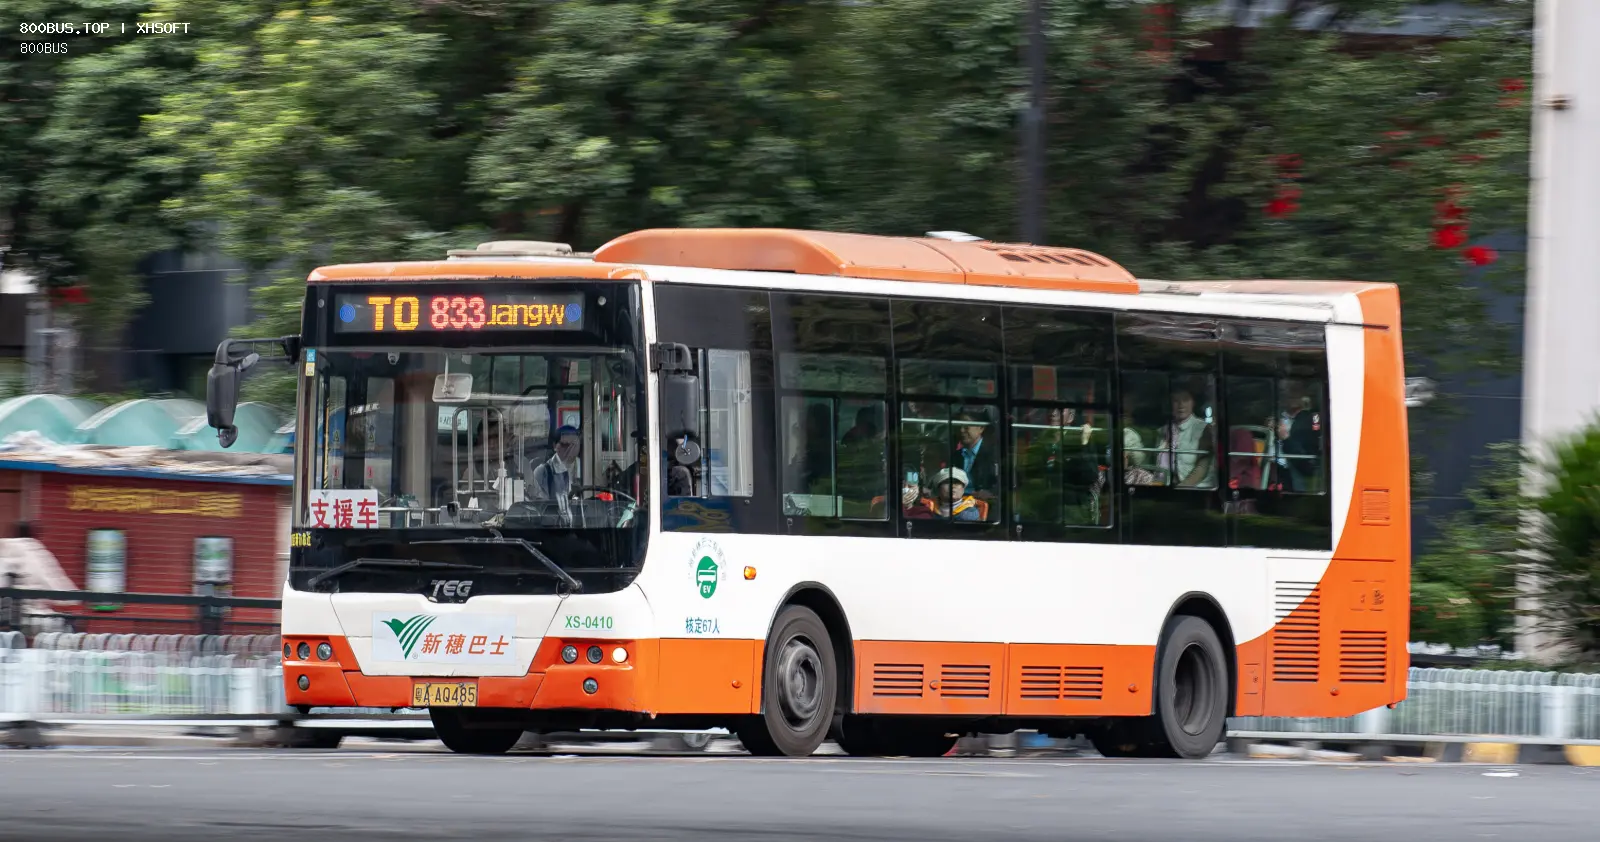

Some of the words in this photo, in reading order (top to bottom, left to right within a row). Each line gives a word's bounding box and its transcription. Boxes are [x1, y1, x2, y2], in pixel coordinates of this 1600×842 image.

[367, 296, 420, 331] TO
[430, 296, 486, 329] 833
[311, 497, 377, 528] 支援车
[430, 580, 474, 597] TEG
[702, 584, 712, 594] EV
[565, 615, 613, 629] XS-0410
[685, 616, 720, 634] 核定67人
[421, 632, 509, 655] 新穗巴士
